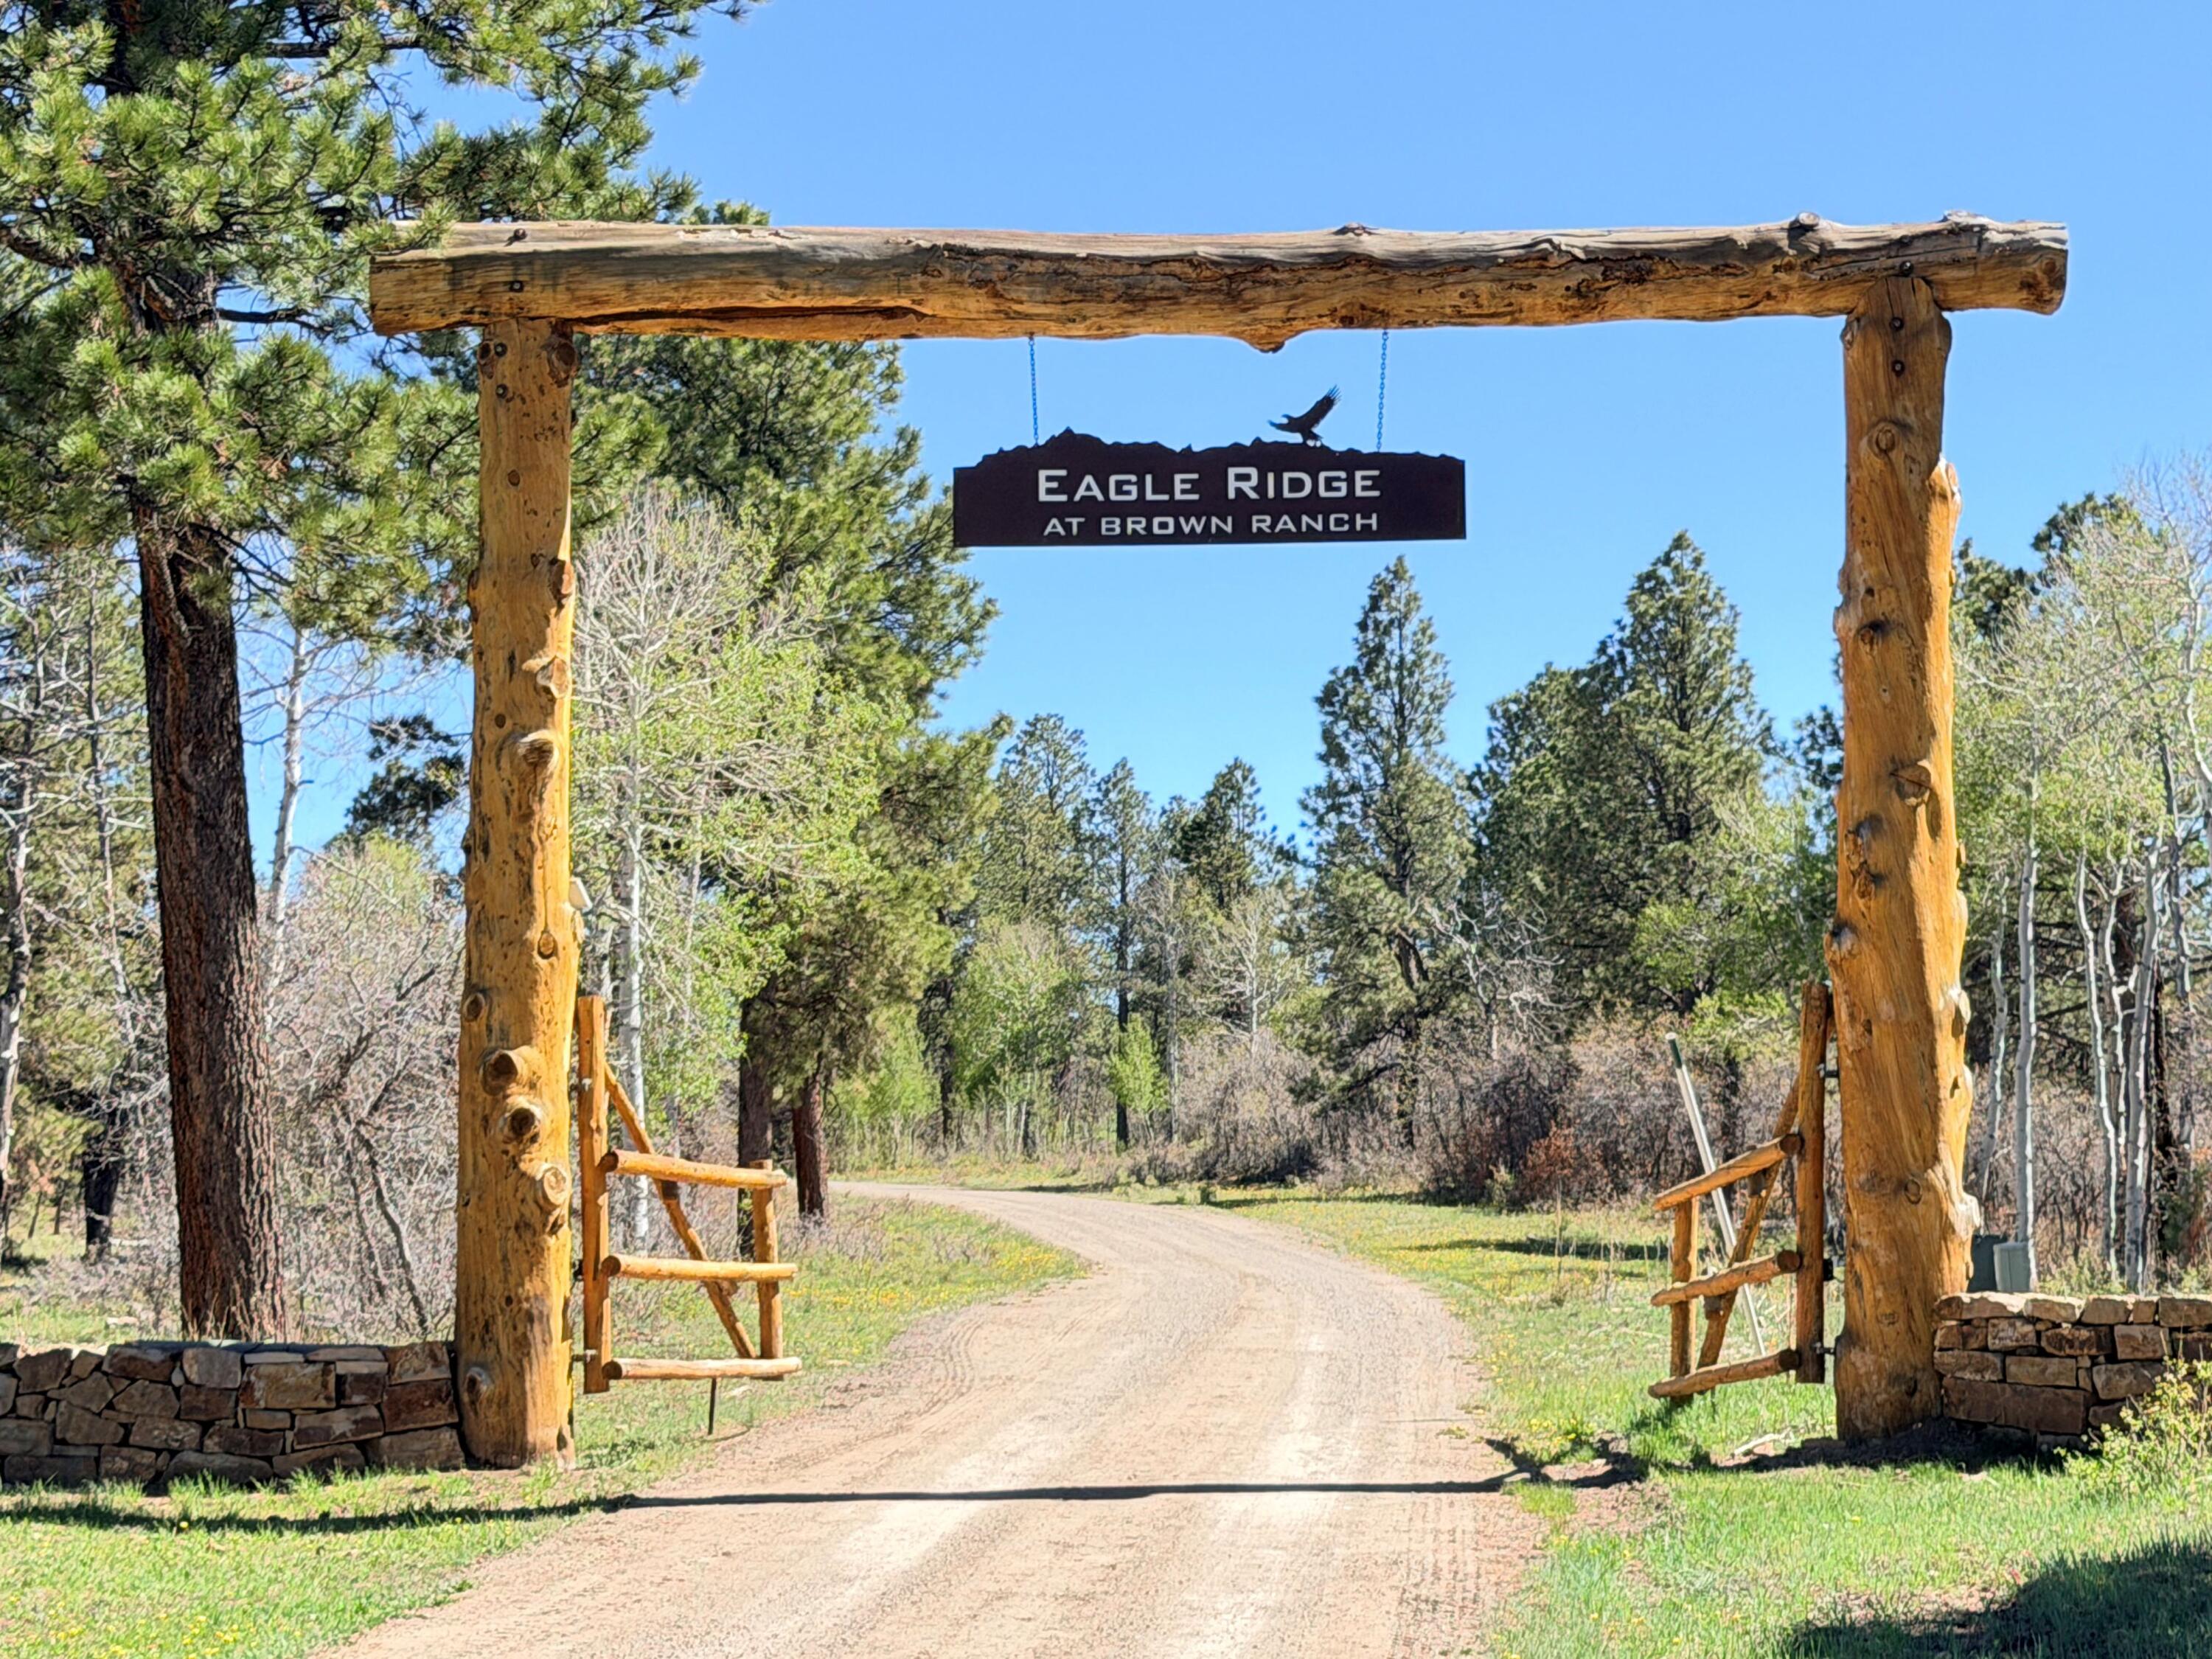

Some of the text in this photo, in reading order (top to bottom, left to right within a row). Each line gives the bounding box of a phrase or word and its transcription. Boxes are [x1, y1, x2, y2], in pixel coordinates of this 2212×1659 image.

[1037, 466, 1381, 502] EAGLE RIDGE
[1043, 512, 1378, 536] AT BROWN RANCH
